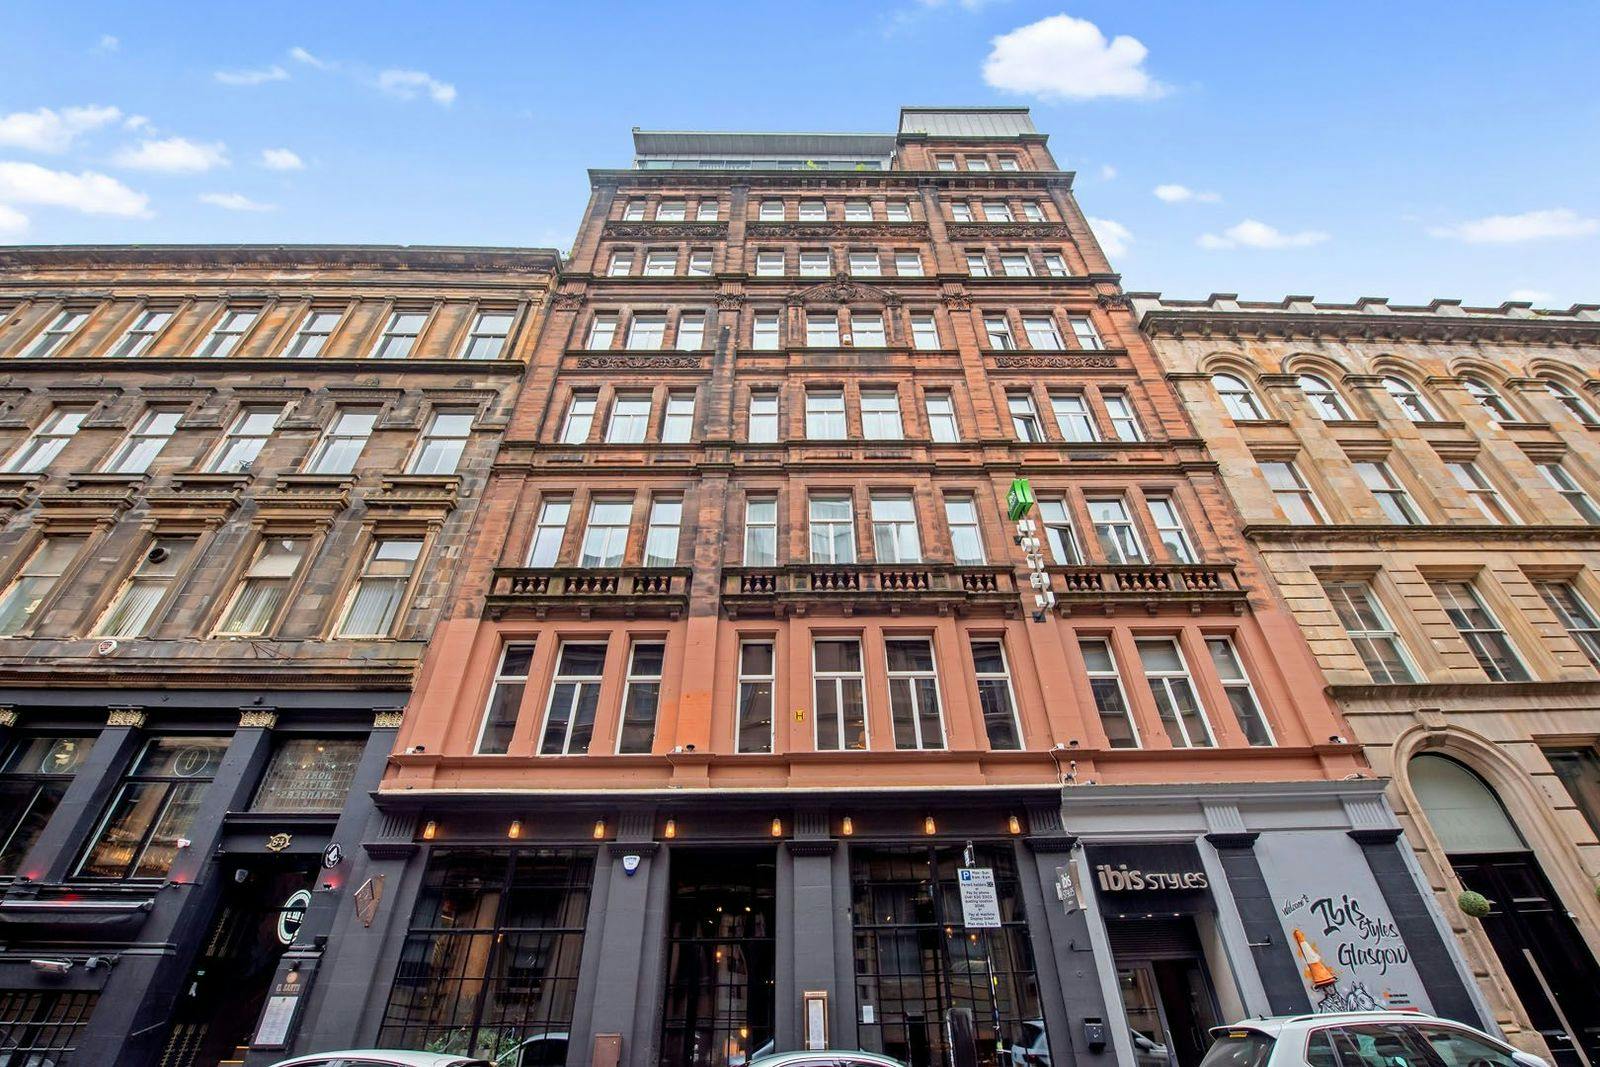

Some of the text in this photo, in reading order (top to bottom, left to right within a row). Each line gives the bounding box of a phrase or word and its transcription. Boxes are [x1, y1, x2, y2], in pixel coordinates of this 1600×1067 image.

[1096, 864, 1145, 891] ibis
[1310, 894, 1365, 936] Ibis
[1359, 917, 1399, 945] Styles
[1337, 942, 1408, 976] Glasgow
